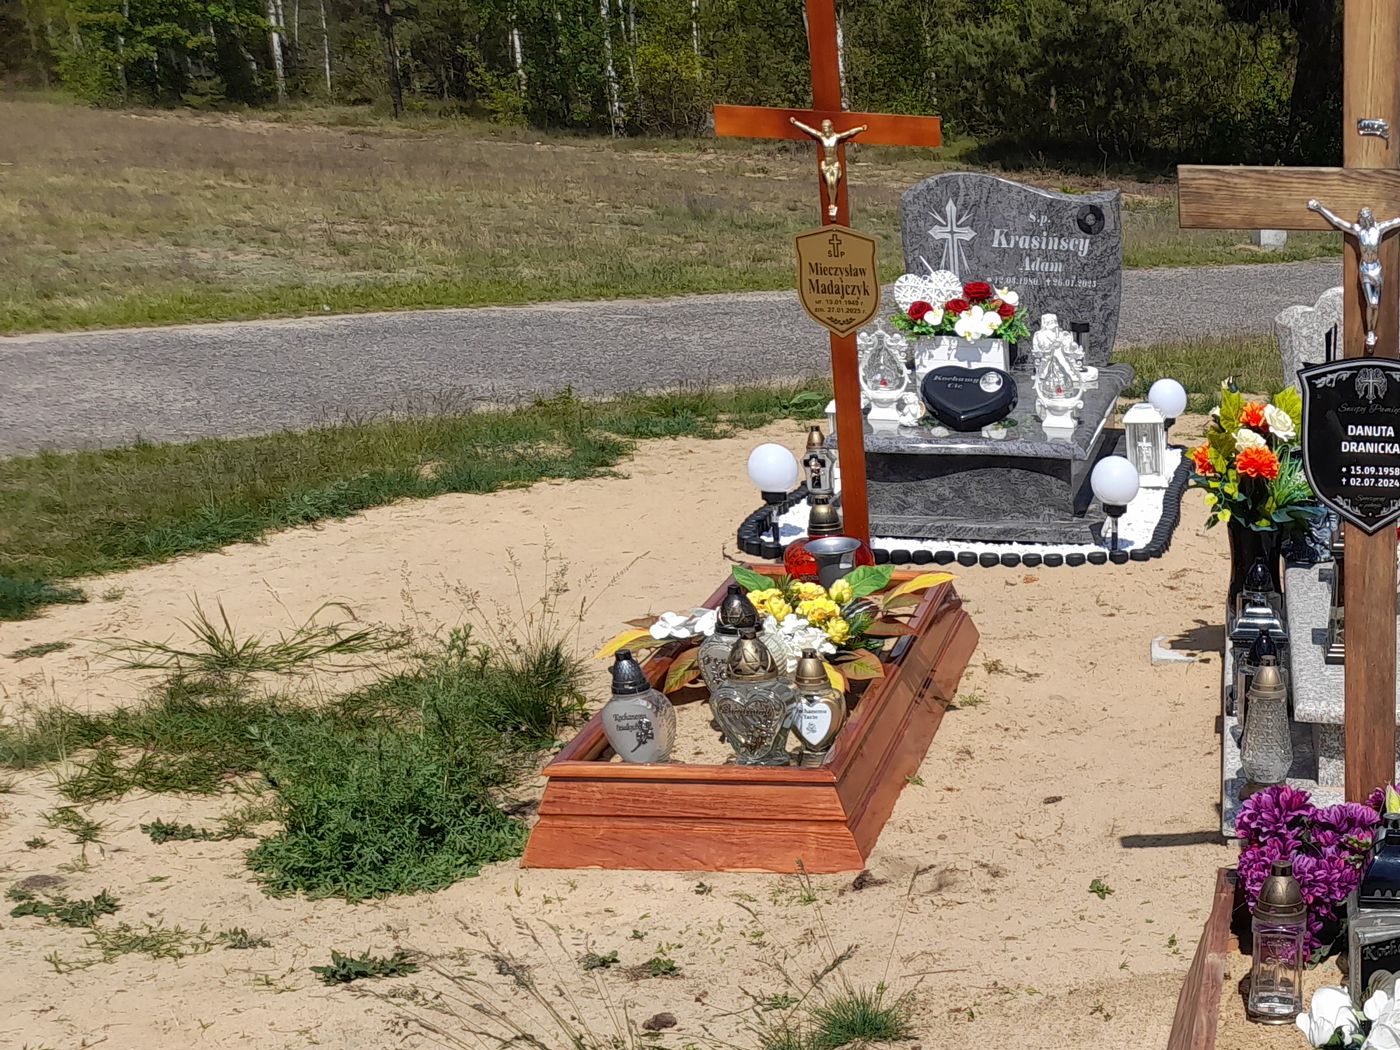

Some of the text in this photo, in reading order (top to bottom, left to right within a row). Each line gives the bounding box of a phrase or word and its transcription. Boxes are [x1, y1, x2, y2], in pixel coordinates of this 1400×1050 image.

[1019, 256, 1063, 272] Adam
[808, 278, 870, 299] Madajczyk
[1347, 424, 1395, 437] DANUTA
[1341, 441, 1400, 454] DRANICKA
[1350, 466, 1400, 476] 15.09.1958
[1350, 477, 1400, 488] 02.07.2024
